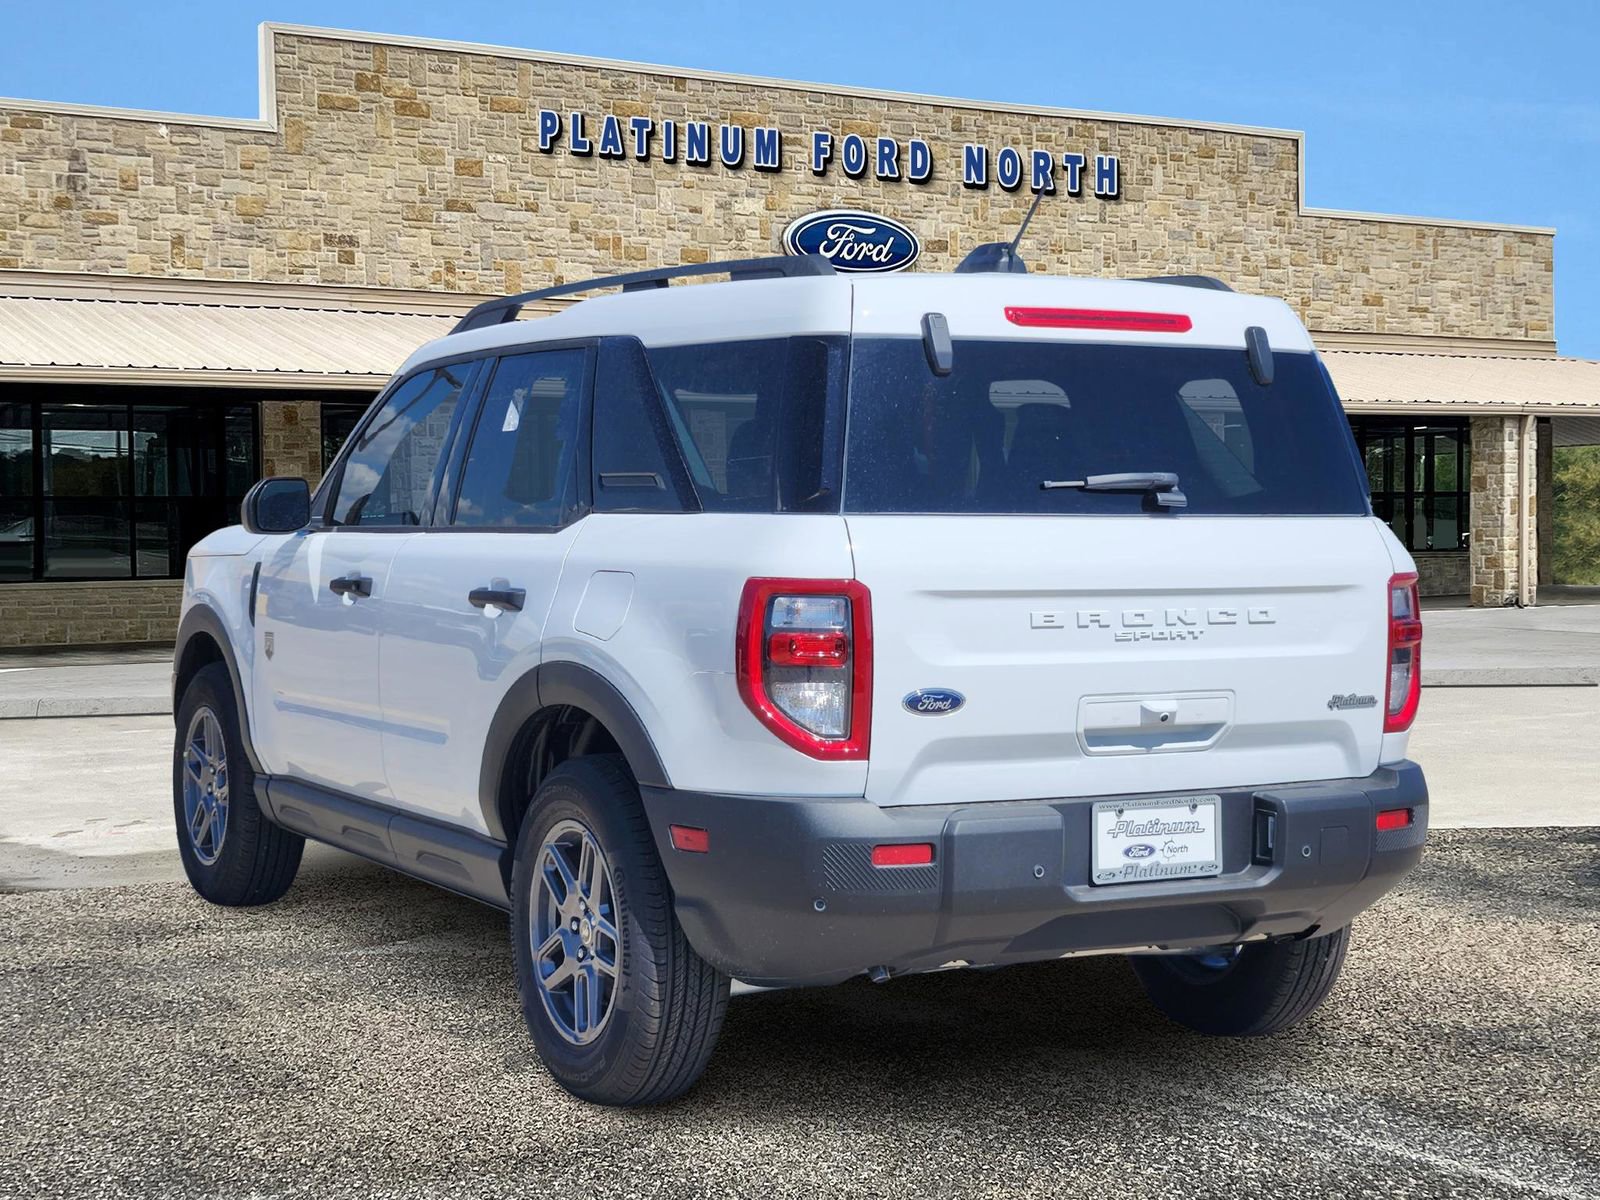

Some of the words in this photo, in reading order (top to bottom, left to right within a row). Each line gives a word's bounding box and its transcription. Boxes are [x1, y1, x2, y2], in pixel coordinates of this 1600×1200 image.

[538, 110, 781, 172] PLATINUM
[812, 131, 933, 184] FORD
[963, 143, 1120, 200] NORTH
[818, 222, 894, 265] Ford
[1030, 608, 1277, 629] BRONCO
[1114, 630, 1204, 642] SPORT
[918, 694, 952, 711] Ford
[1107, 818, 1205, 838] Platinum
[1128, 846, 1150, 857] Ford
[1166, 845, 1188, 854] North
[1123, 862, 1198, 879] Platinum
